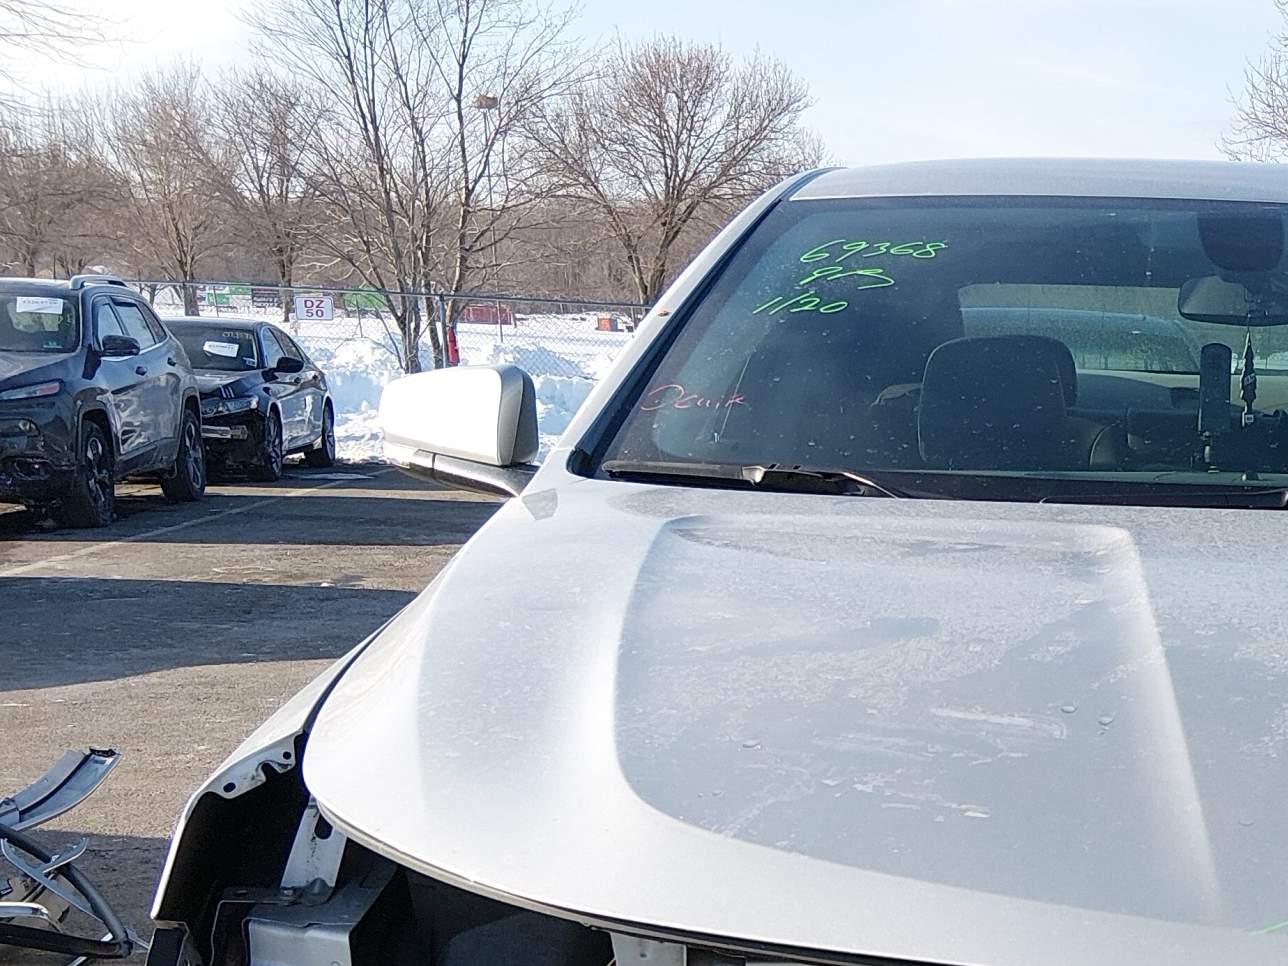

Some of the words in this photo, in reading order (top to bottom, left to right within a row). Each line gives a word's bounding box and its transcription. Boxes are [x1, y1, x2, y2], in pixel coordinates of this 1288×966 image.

[800, 239, 948, 263] 69368
[303, 299, 325, 309] DZ
[305, 309, 325, 318] 50
